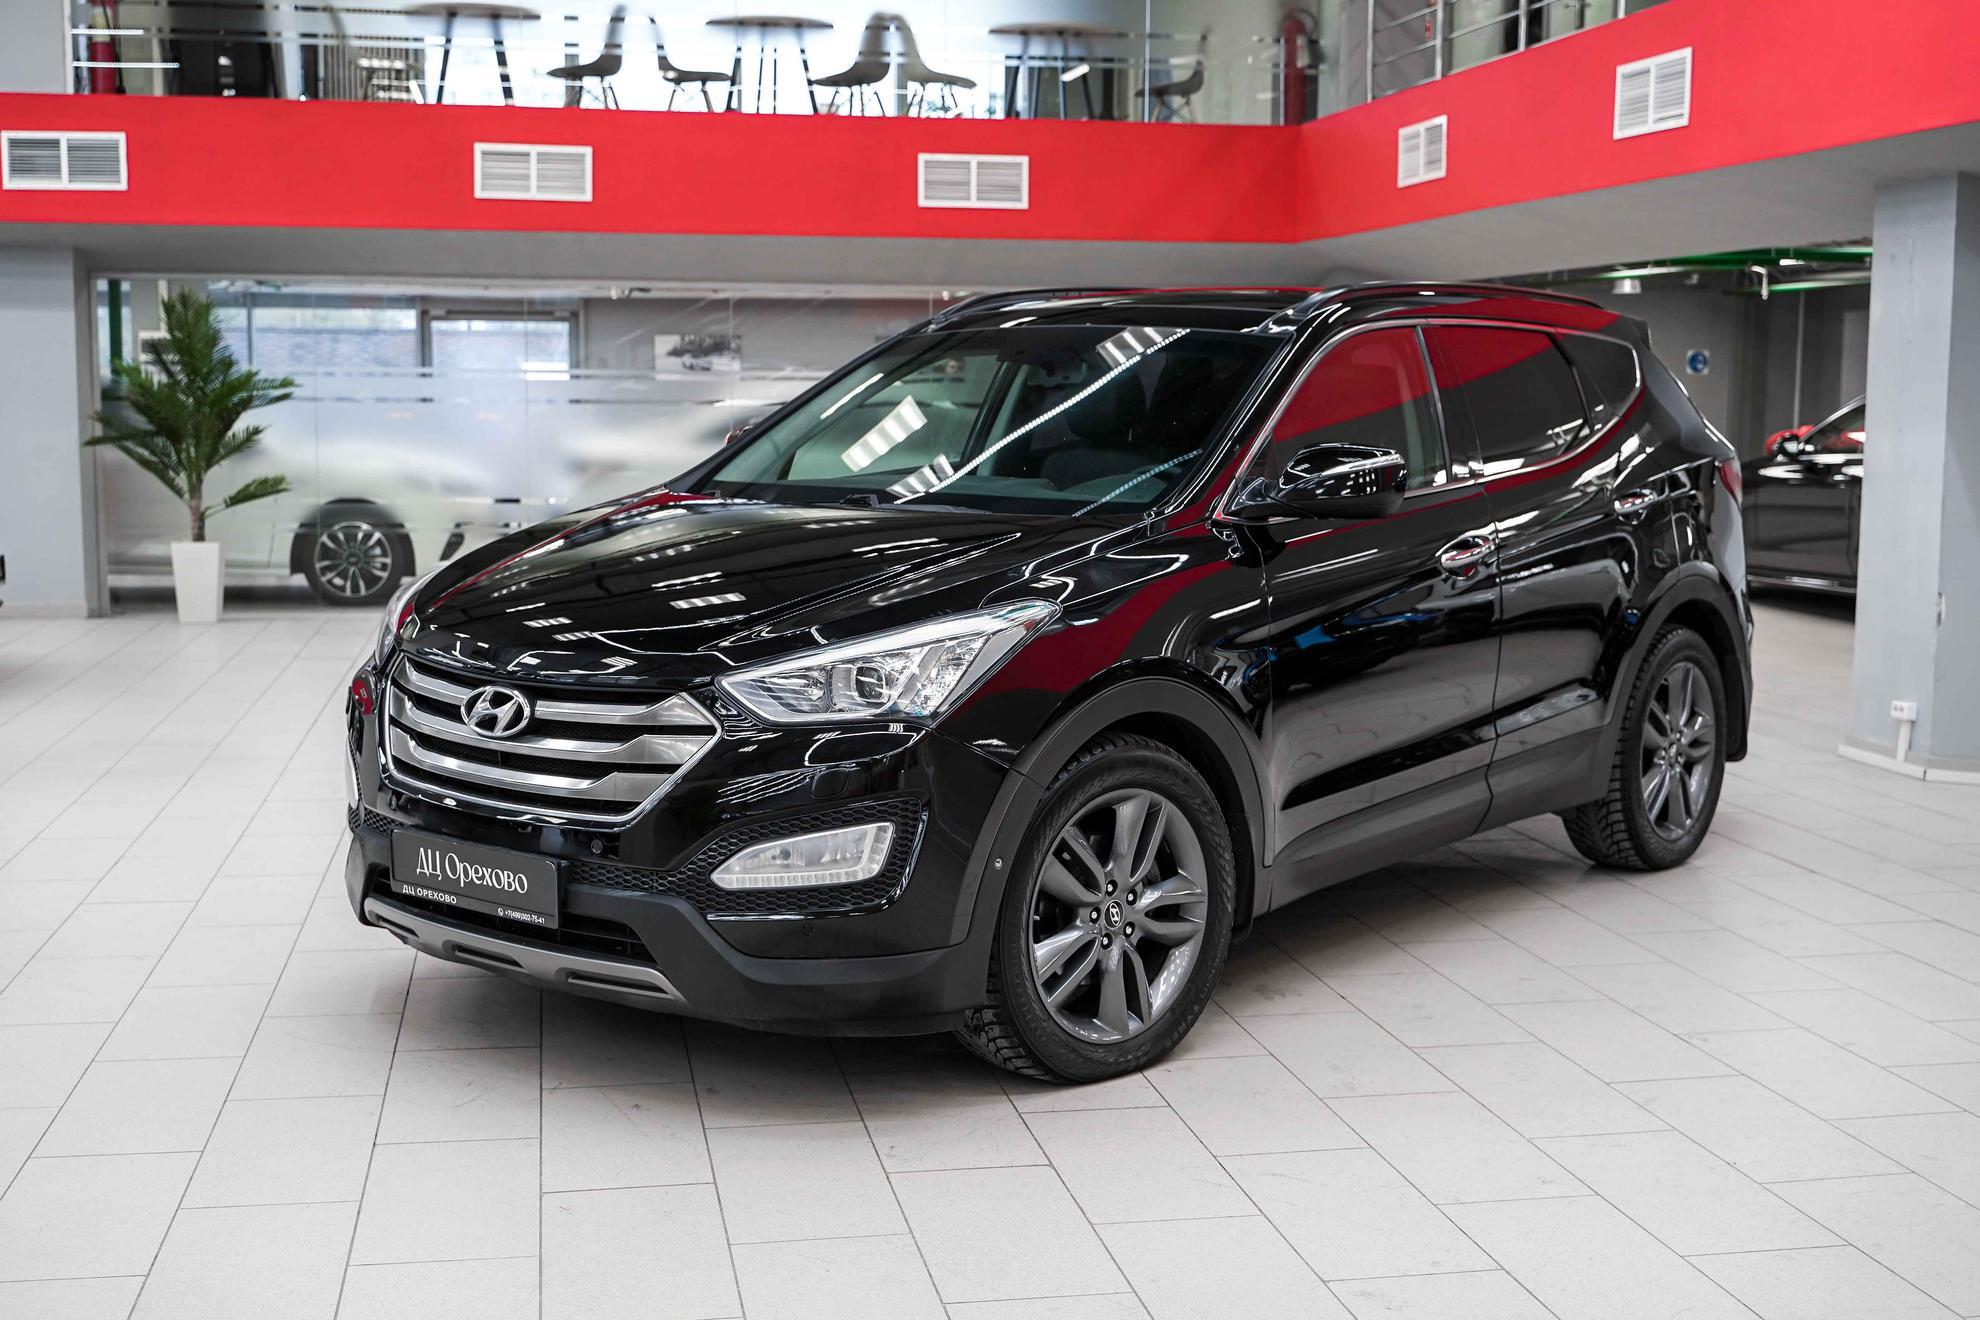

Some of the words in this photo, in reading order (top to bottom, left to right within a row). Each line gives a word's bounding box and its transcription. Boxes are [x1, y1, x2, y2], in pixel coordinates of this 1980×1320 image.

[416, 847, 442, 881] ДЦ
[445, 852, 528, 894] Орехово
[402, 884, 416, 896] ДЦ
[416, 887, 457, 904] ОРЕХОВО
